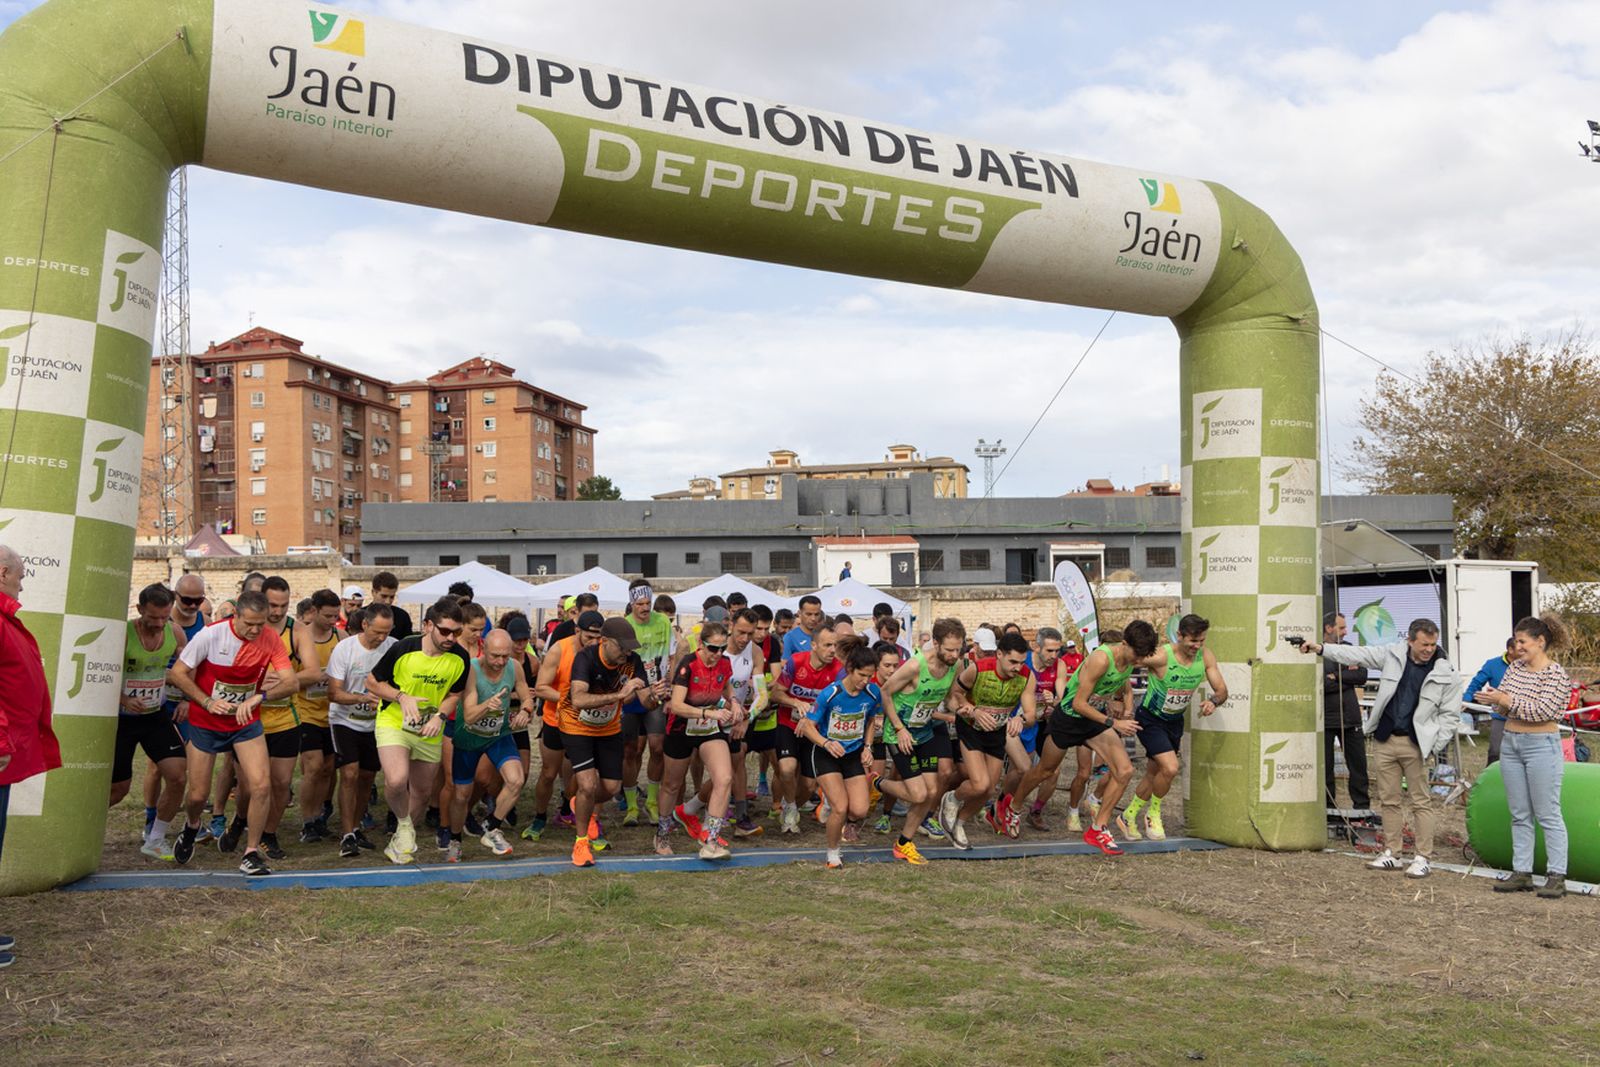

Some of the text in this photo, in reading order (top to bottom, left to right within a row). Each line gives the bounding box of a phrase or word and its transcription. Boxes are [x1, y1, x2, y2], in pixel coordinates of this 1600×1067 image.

[267, 45, 396, 120] Jaén
[265, 102, 393, 139] Paraíso interior
[462, 42, 1079, 198] DIPUTACIÓN DE JAÉN
[583, 128, 986, 243] DEPORTES
[1119, 211, 1201, 262] Jaén
[4, 257, 90, 276] DEPORTES
[1156, 264, 1195, 276] interior
[12, 355, 82, 372] DIPUTACIÓN
[11, 367, 58, 380] DE JAÉN
[1211, 419, 1254, 428] DIPUTACIÓN
[1270, 419, 1312, 428] DEPORTES
[107, 480, 117, 490] DE
[1267, 556, 1312, 564] DEPORTES
[86, 673, 97, 683] DE
[1264, 694, 1313, 702] DEPORTES
[834, 720, 857, 731] 484
